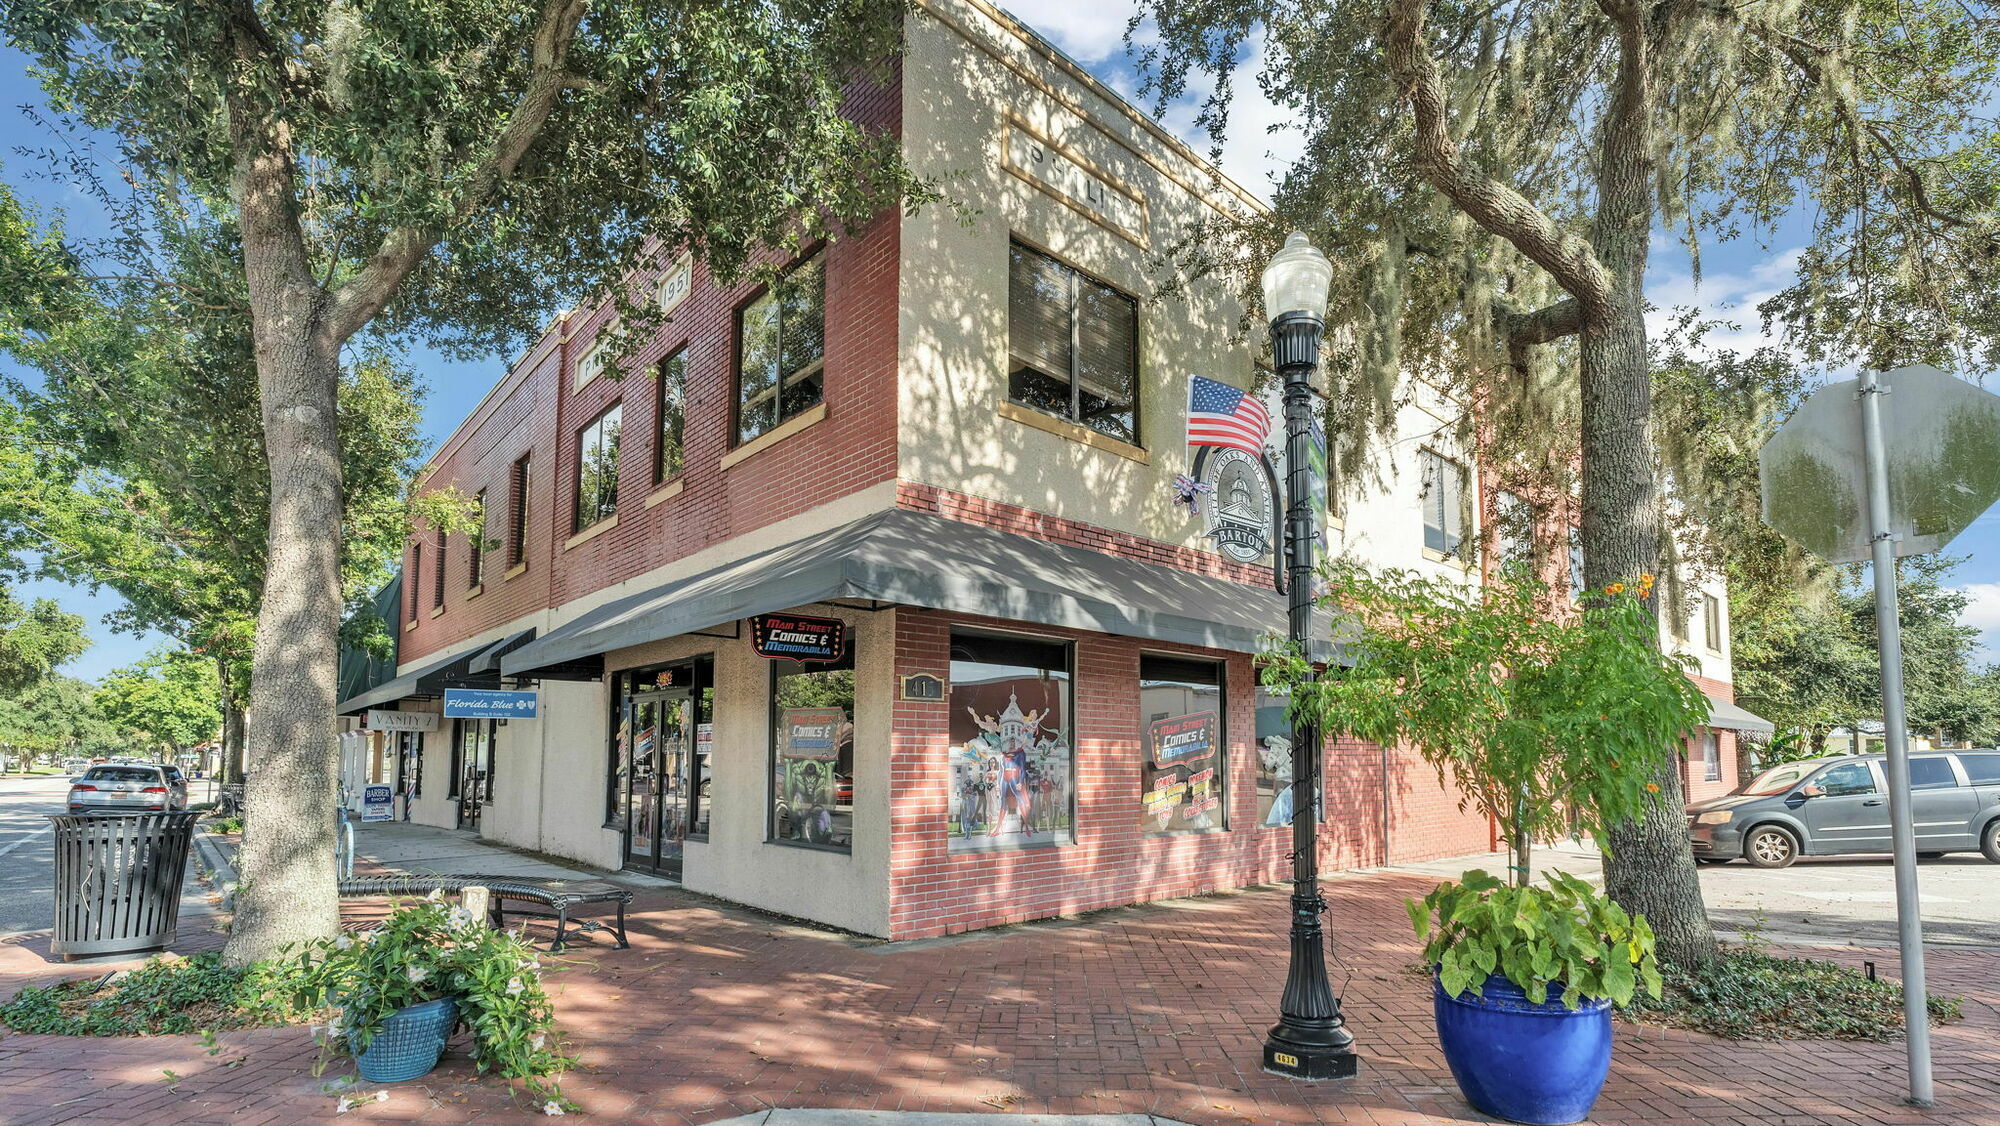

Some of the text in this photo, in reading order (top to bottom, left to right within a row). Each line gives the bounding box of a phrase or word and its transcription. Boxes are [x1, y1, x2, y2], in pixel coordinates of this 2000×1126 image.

[663, 269, 689, 305] 1951
[1220, 452, 1240, 467] OAKS
[1214, 470, 1221, 483] OF
[1211, 489, 1219, 518] CITY
[1219, 529, 1264, 552] BARTOW
[820, 634, 829, 646] &
[446, 699, 514, 709] Florida Blue
[376, 714, 420, 725] VANITY
[366, 788, 390, 797] BARBER
